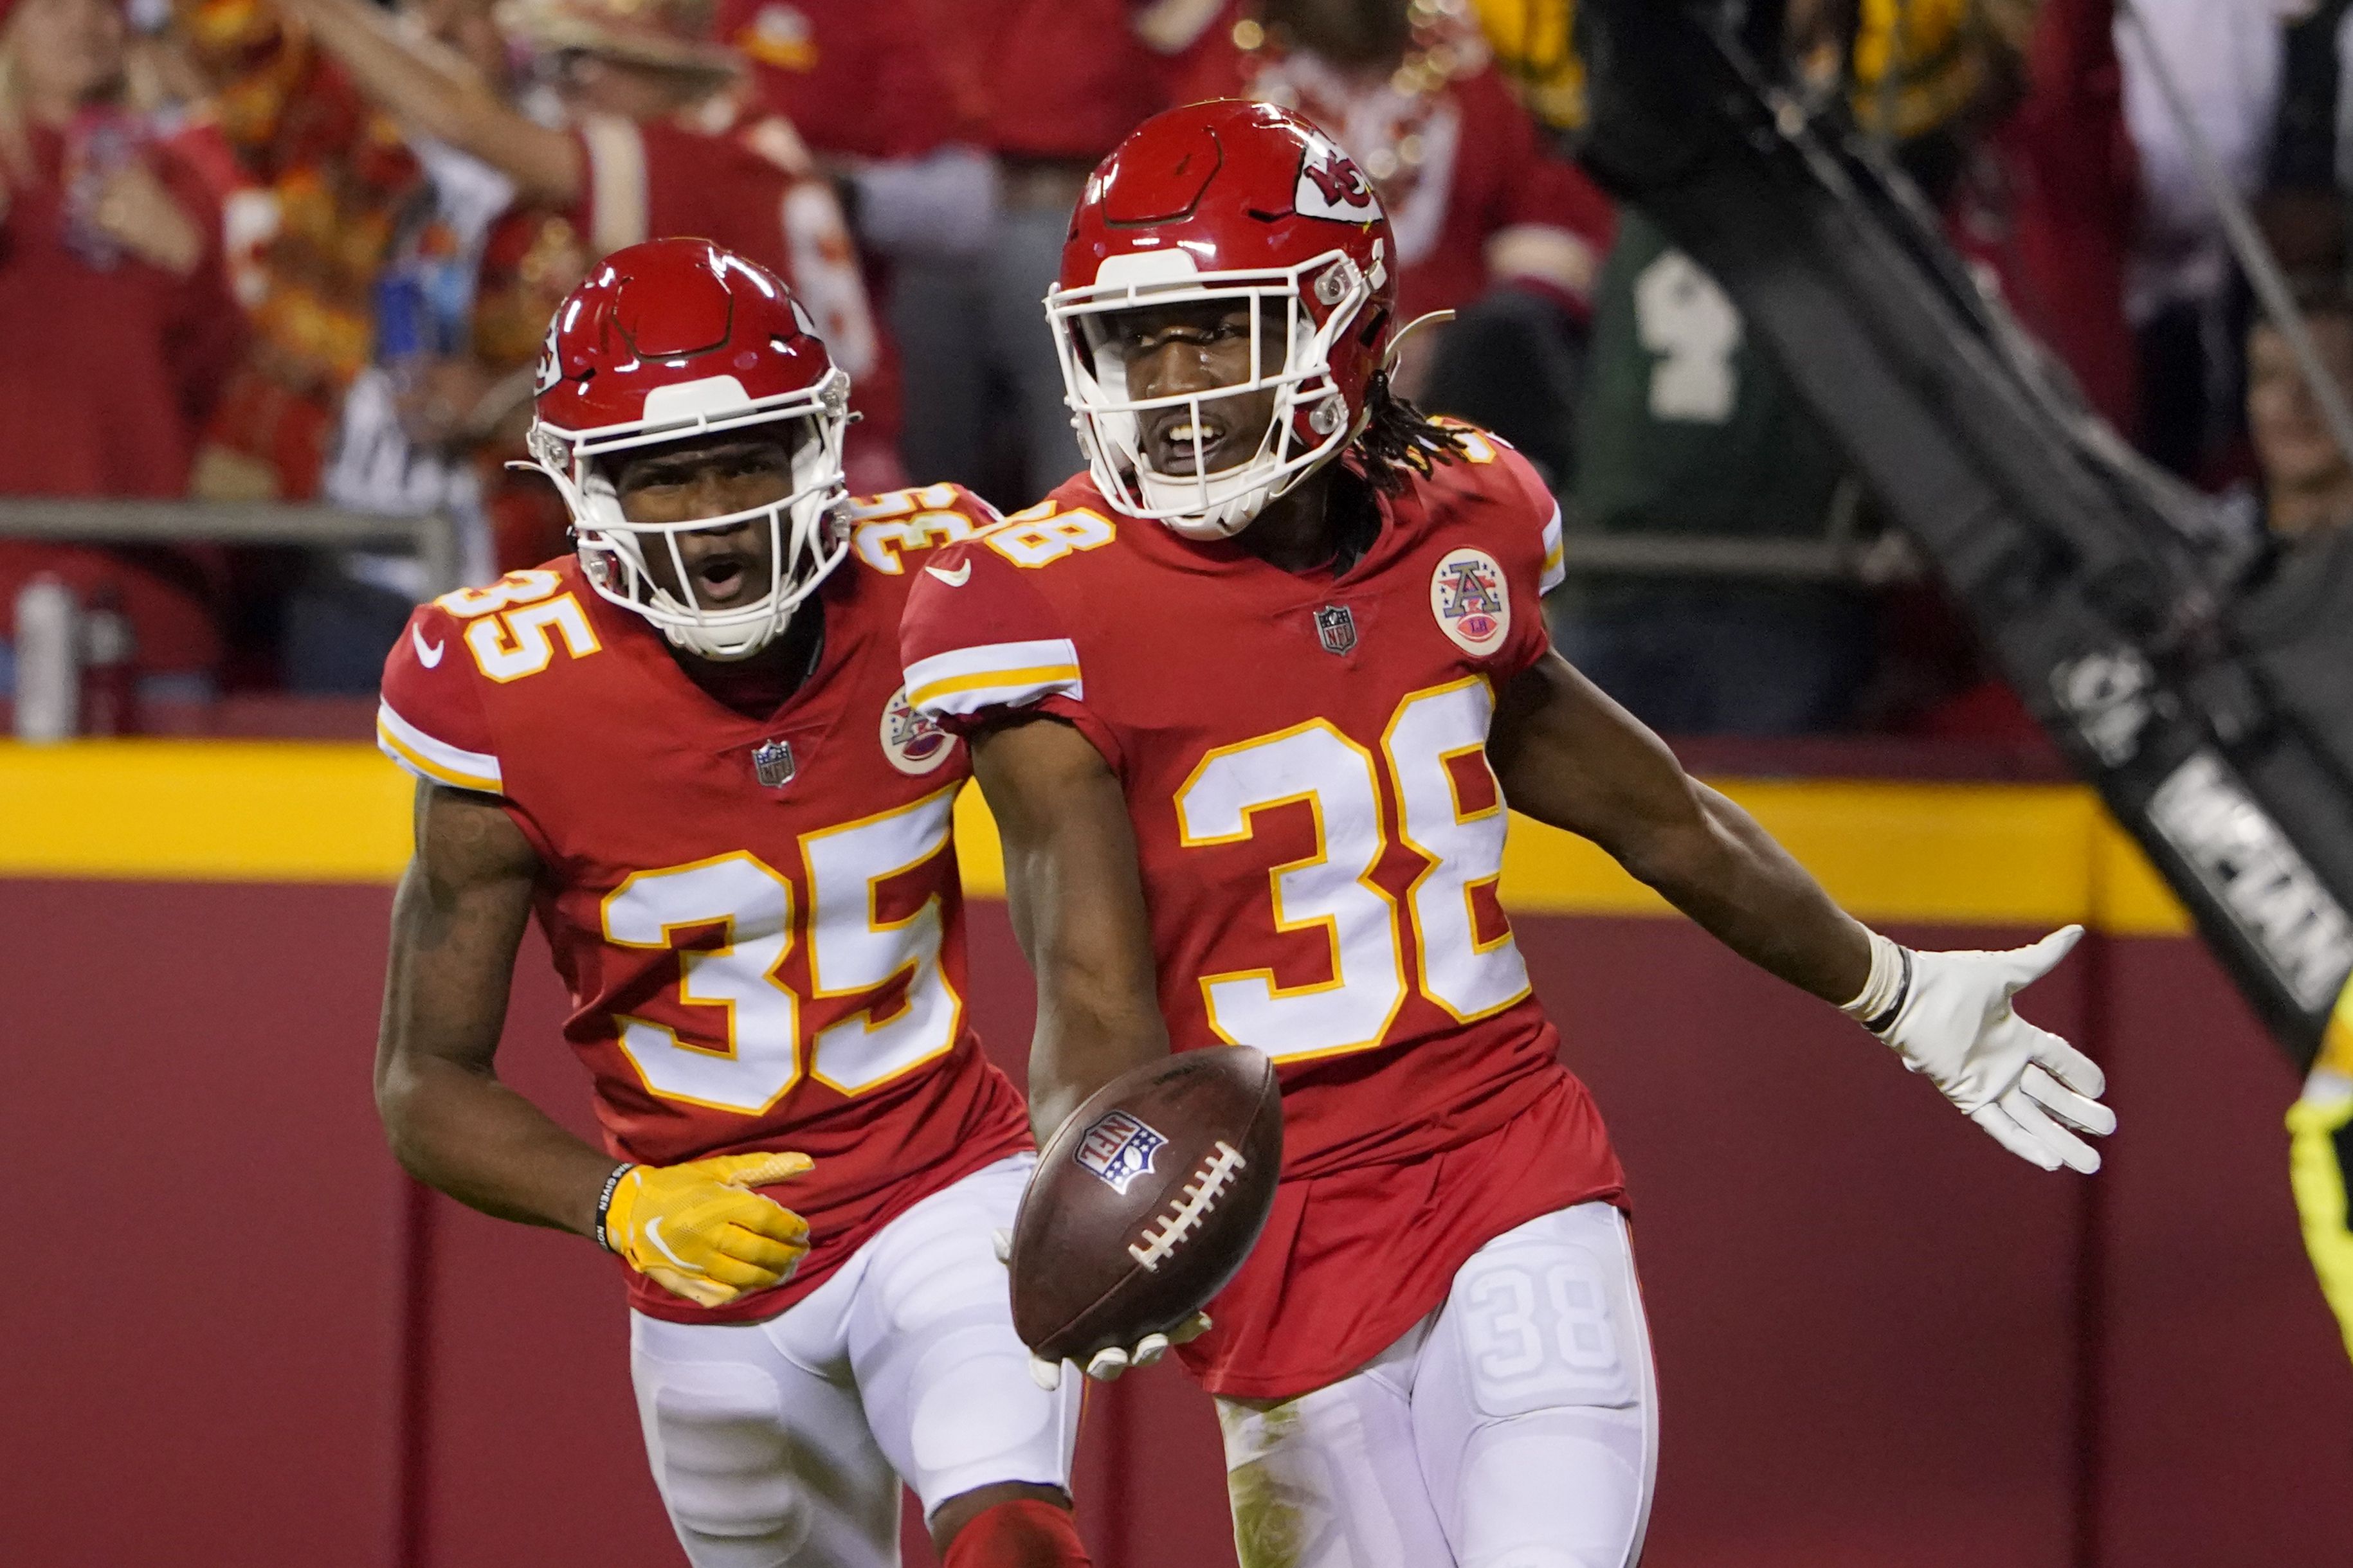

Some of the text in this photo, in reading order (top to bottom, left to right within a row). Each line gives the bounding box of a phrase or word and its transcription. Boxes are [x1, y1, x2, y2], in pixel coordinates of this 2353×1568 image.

[1304, 150, 1372, 208] KC
[434, 570, 603, 684] 35
[1173, 672, 1532, 1064] 38
[601, 779, 962, 1117] 35
[598, 1177, 617, 1211] GIVEN
[1080, 1116, 1136, 1164] NFL
[1469, 1263, 1617, 1380] 38
